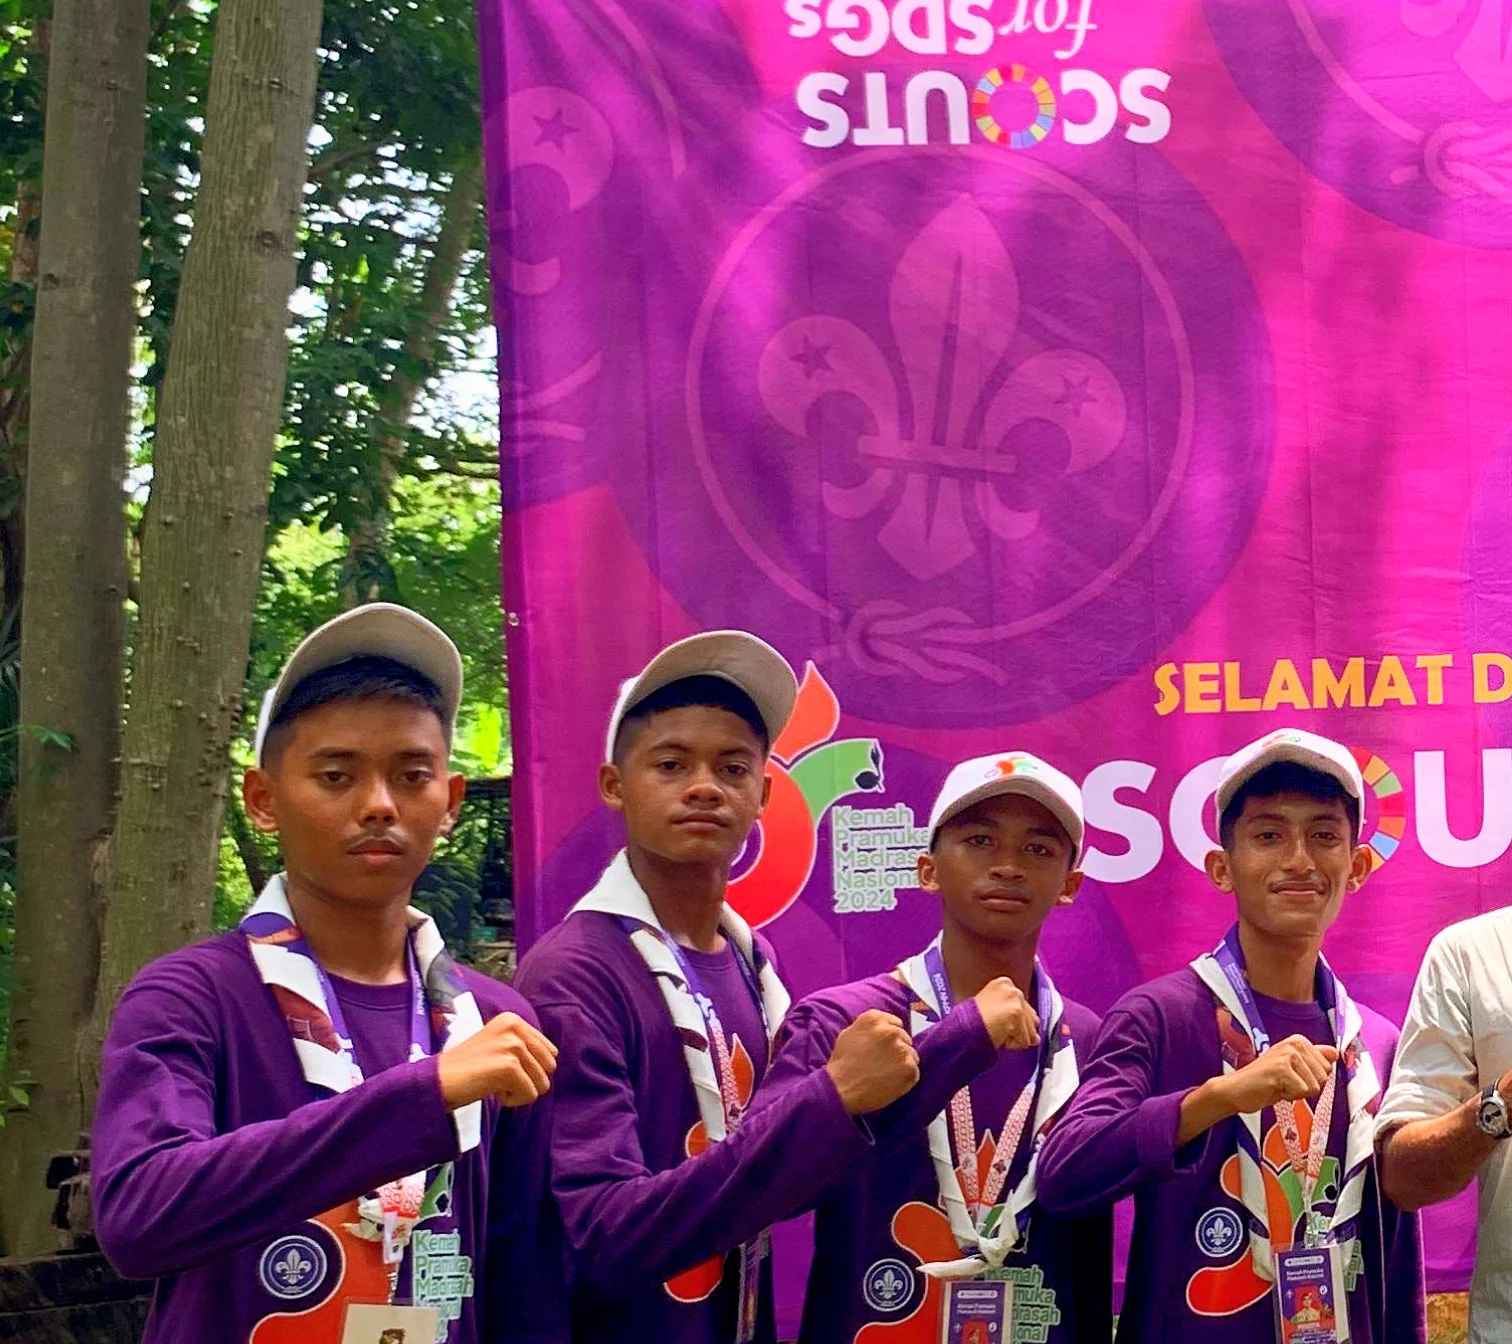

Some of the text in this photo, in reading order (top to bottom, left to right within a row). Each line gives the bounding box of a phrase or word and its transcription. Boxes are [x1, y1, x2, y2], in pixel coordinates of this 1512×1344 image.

[796, 63, 1172, 149] SCOUTS
[1152, 653, 1454, 717] SELAMAT
[834, 803, 911, 827] Kemah
[835, 846, 917, 869] Madras
[837, 889, 893, 910] 2024
[1014, 1286, 1054, 1304] muka
